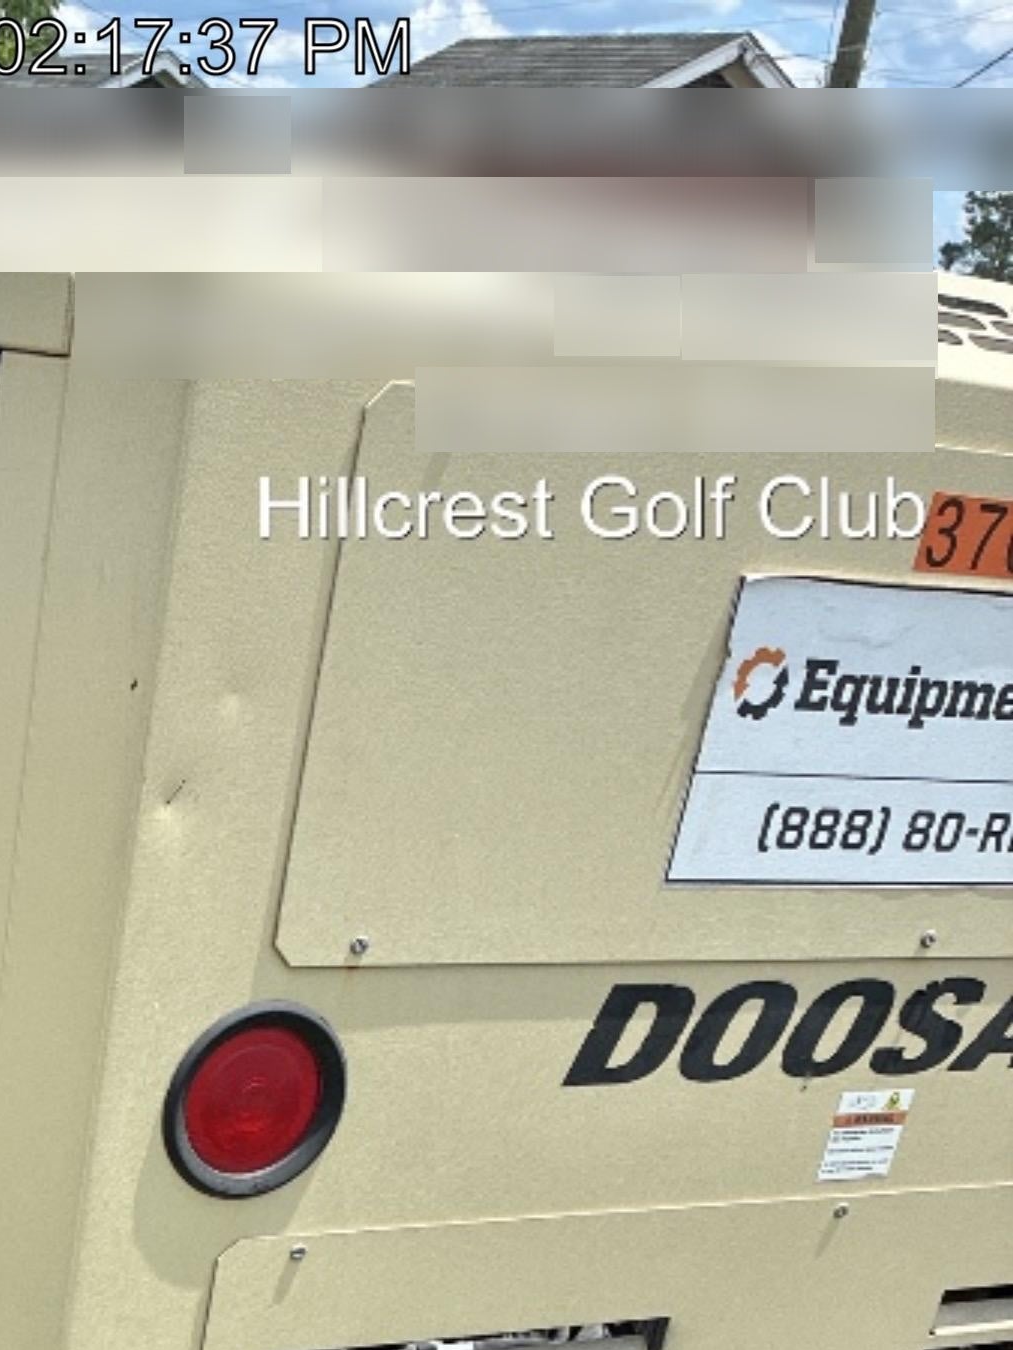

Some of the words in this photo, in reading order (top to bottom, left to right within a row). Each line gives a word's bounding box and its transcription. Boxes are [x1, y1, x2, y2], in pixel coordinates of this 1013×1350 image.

[926, 497, 1013, 574] 37
[757, 802, 891, 856] (888)
[902, 810, 1013, 853] 80-R
